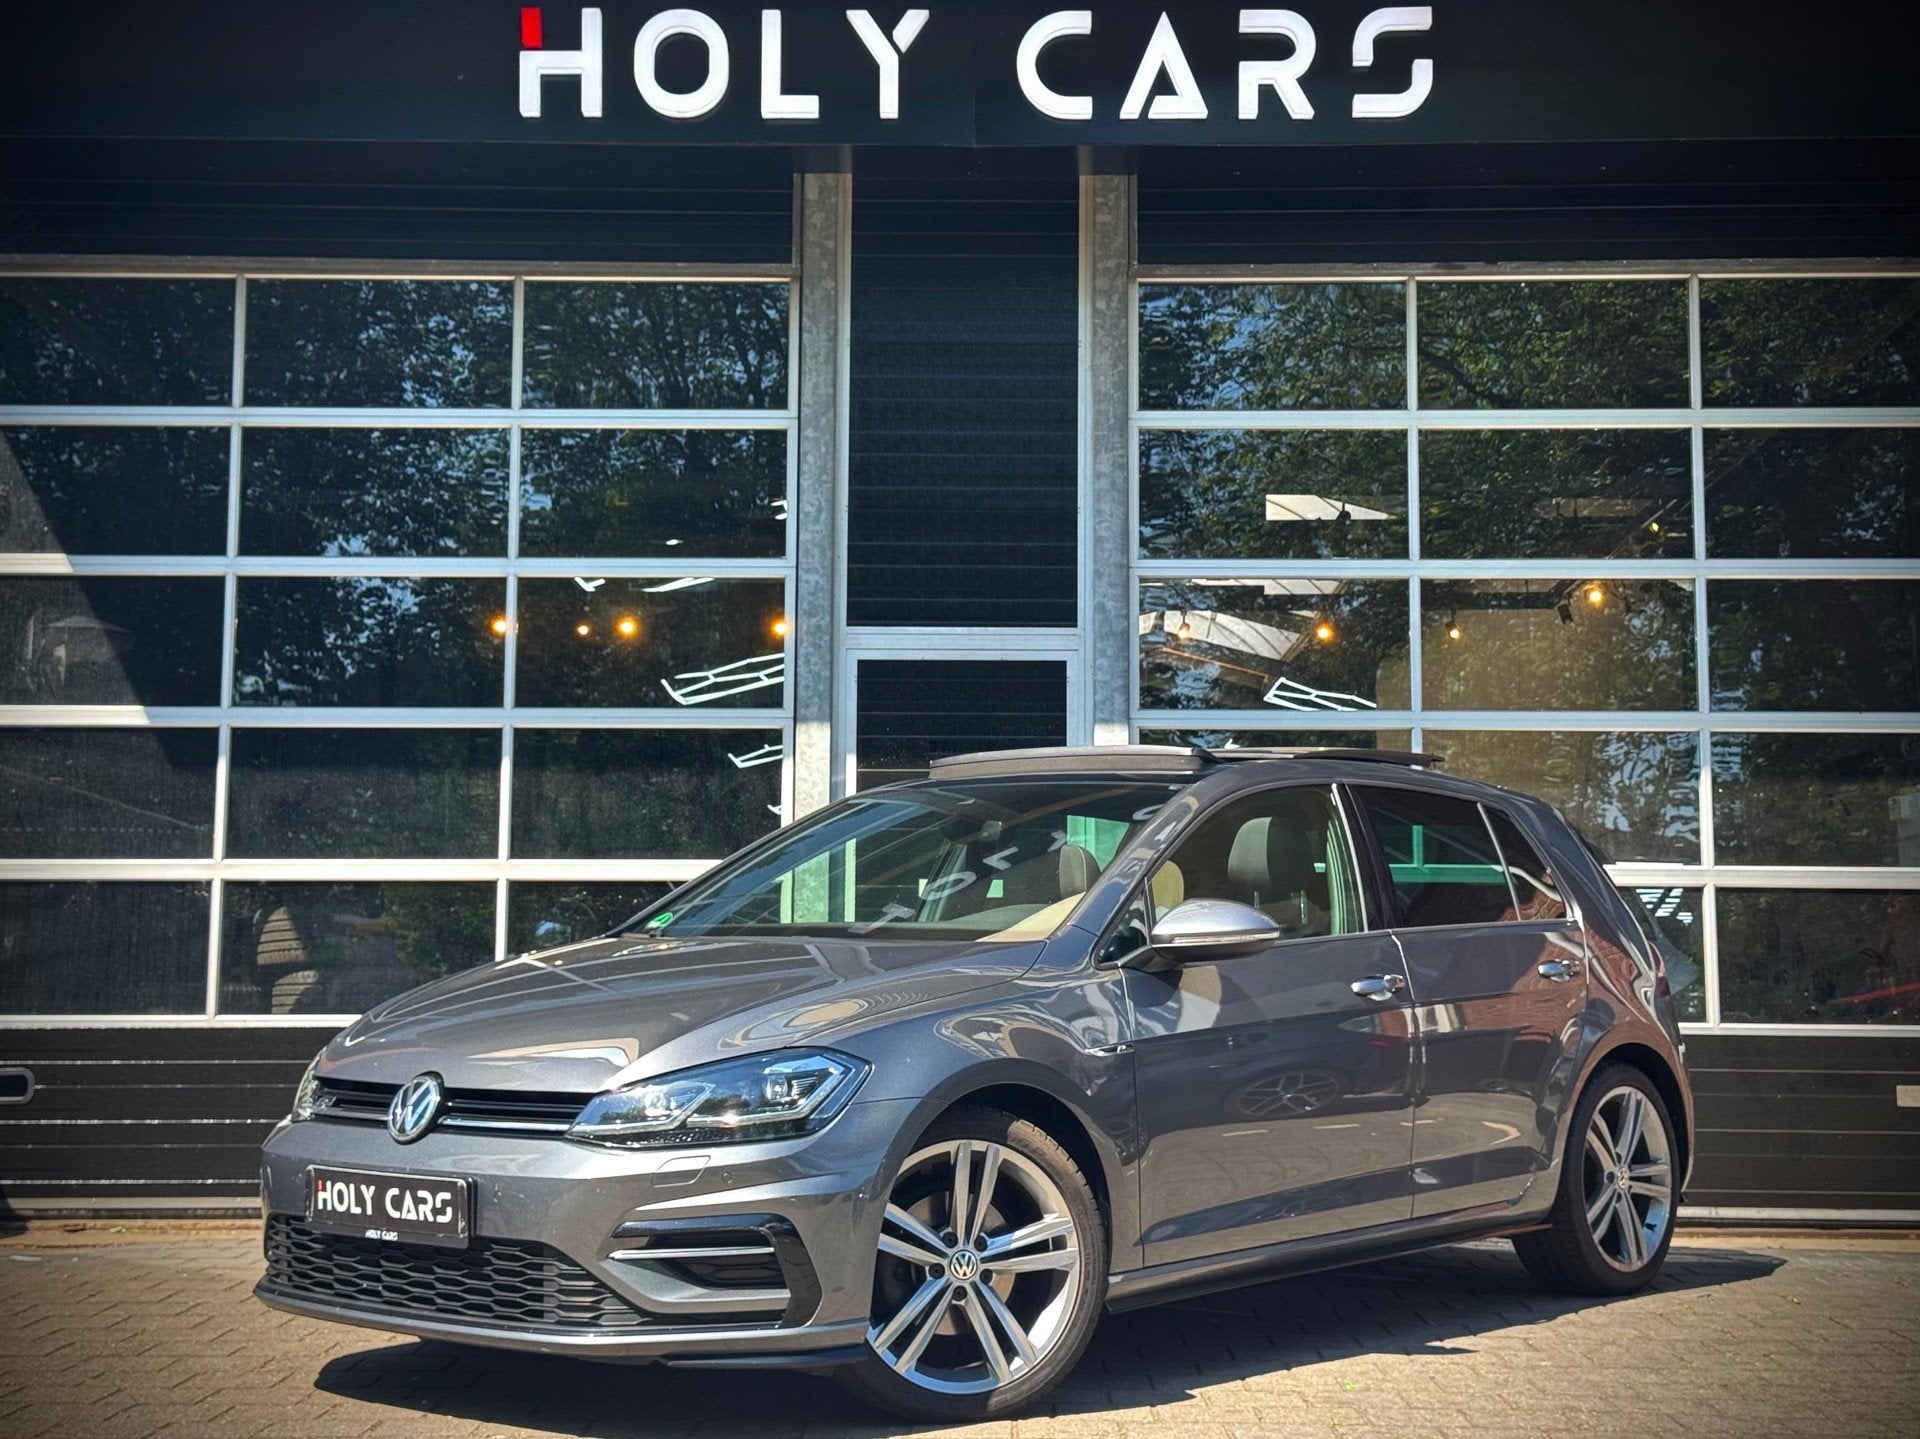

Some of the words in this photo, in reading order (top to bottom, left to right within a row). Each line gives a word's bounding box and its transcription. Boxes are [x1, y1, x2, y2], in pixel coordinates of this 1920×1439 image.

[518, 7, 930, 119] HOLY
[1015, 6, 1434, 121] CARS
[316, 1178, 376, 1216] HOLY
[384, 1187, 453, 1224] CARS
